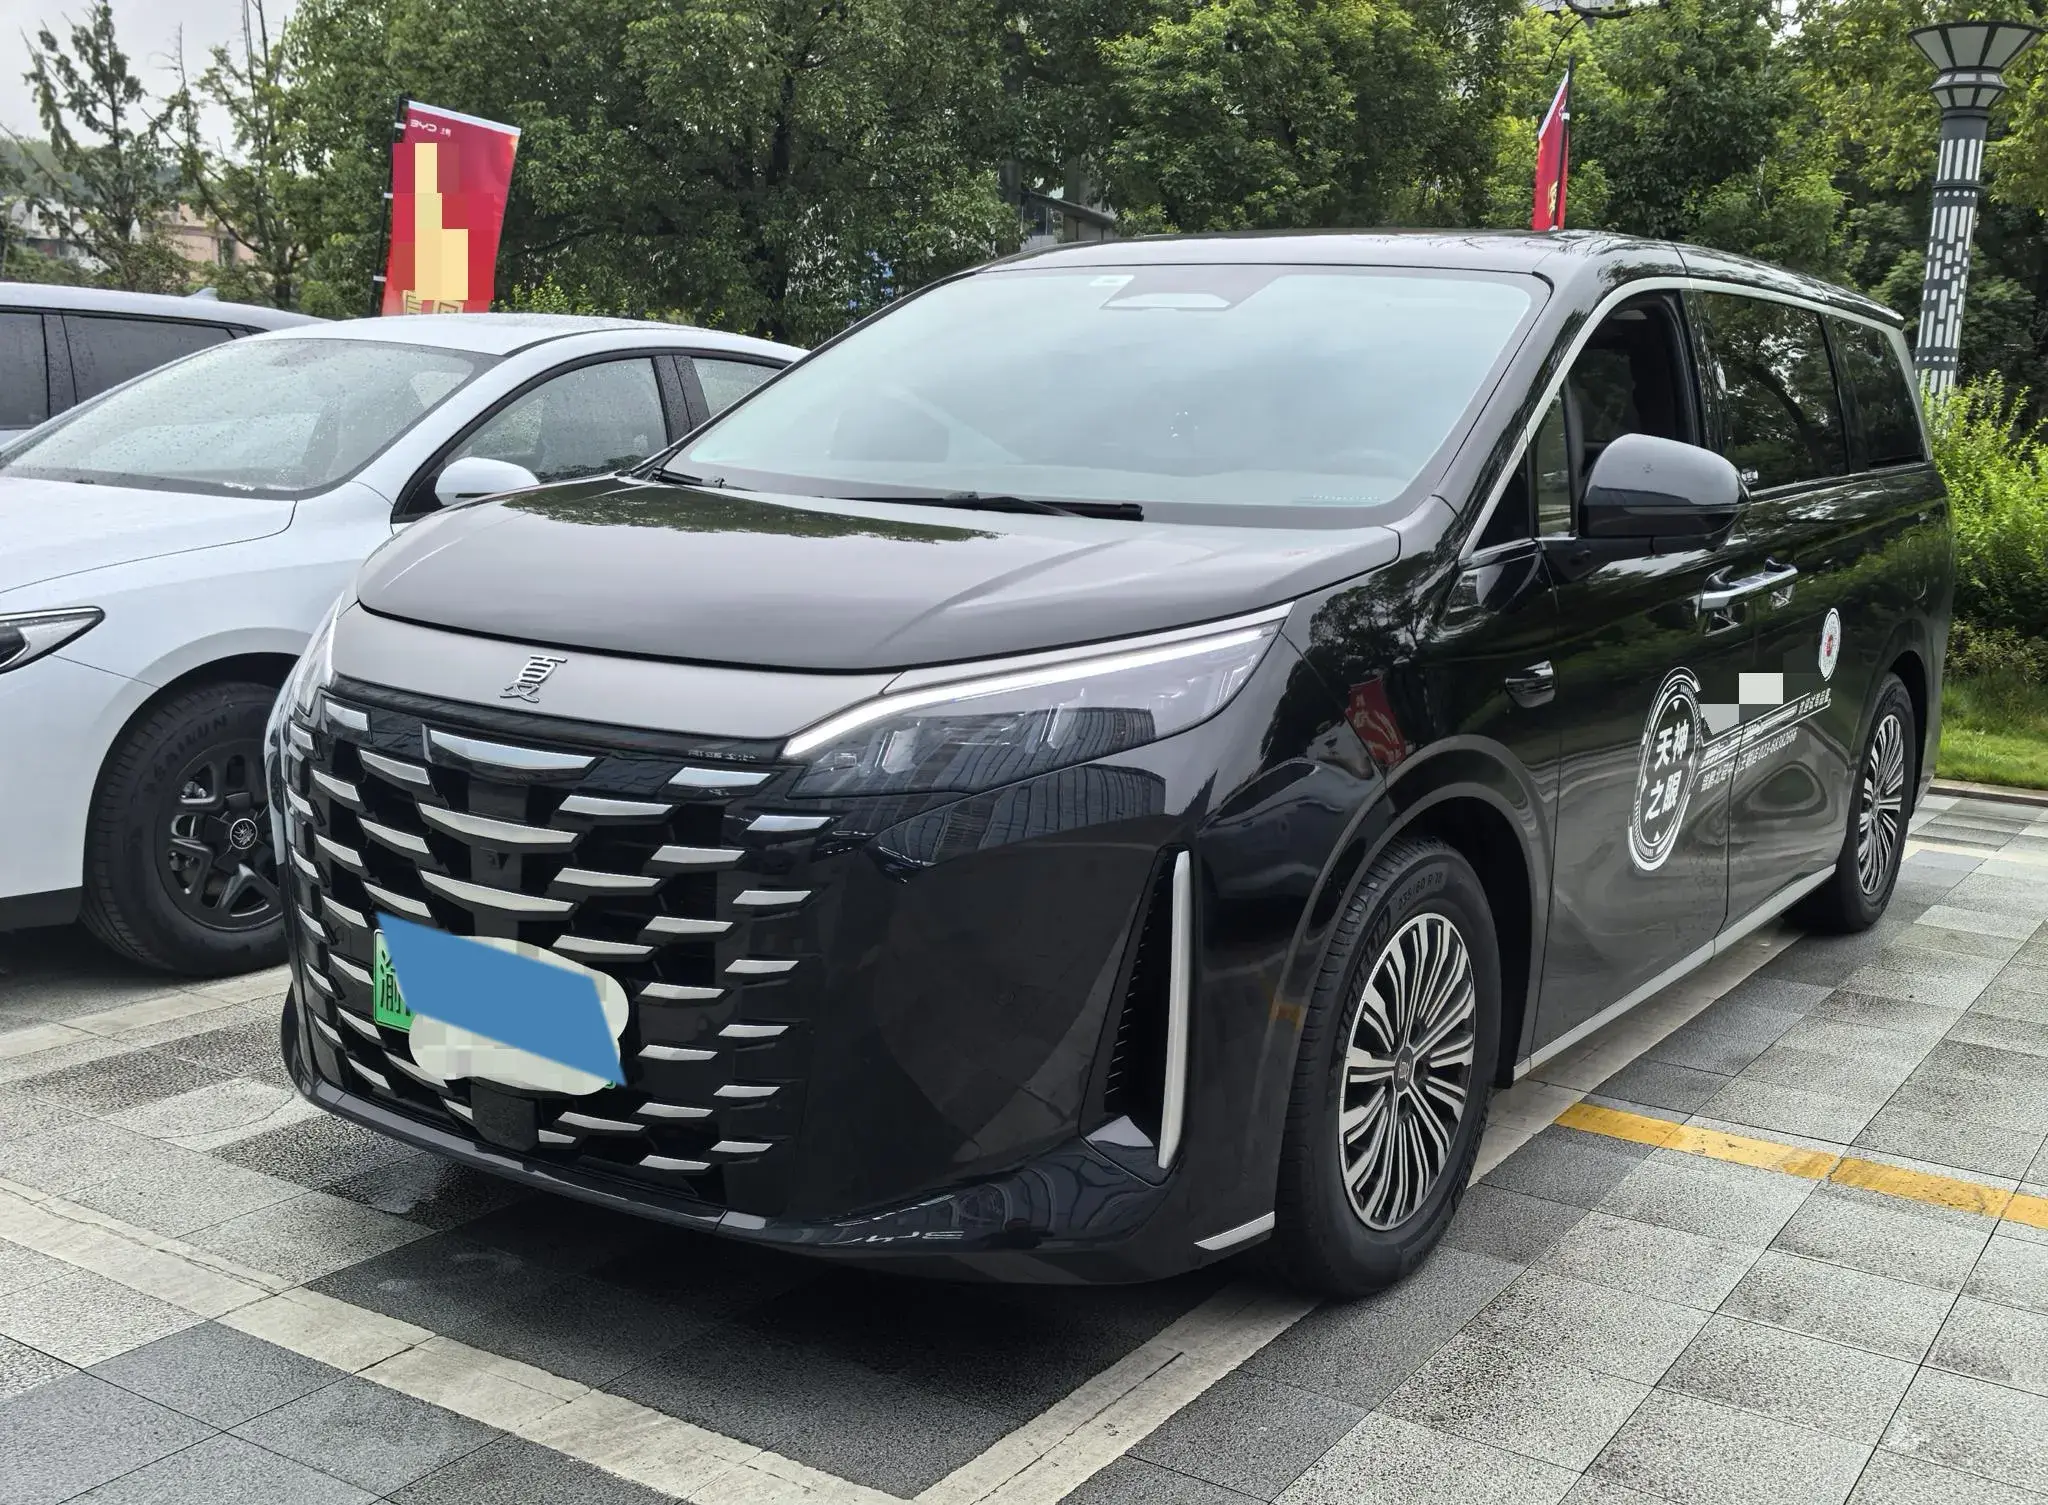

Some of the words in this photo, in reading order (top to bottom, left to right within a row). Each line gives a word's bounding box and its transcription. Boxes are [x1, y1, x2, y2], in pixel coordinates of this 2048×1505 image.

[409, 119, 438, 133] BYD
[1654, 719, 1690, 772] 天神
[1644, 769, 1683, 823] 之眼
